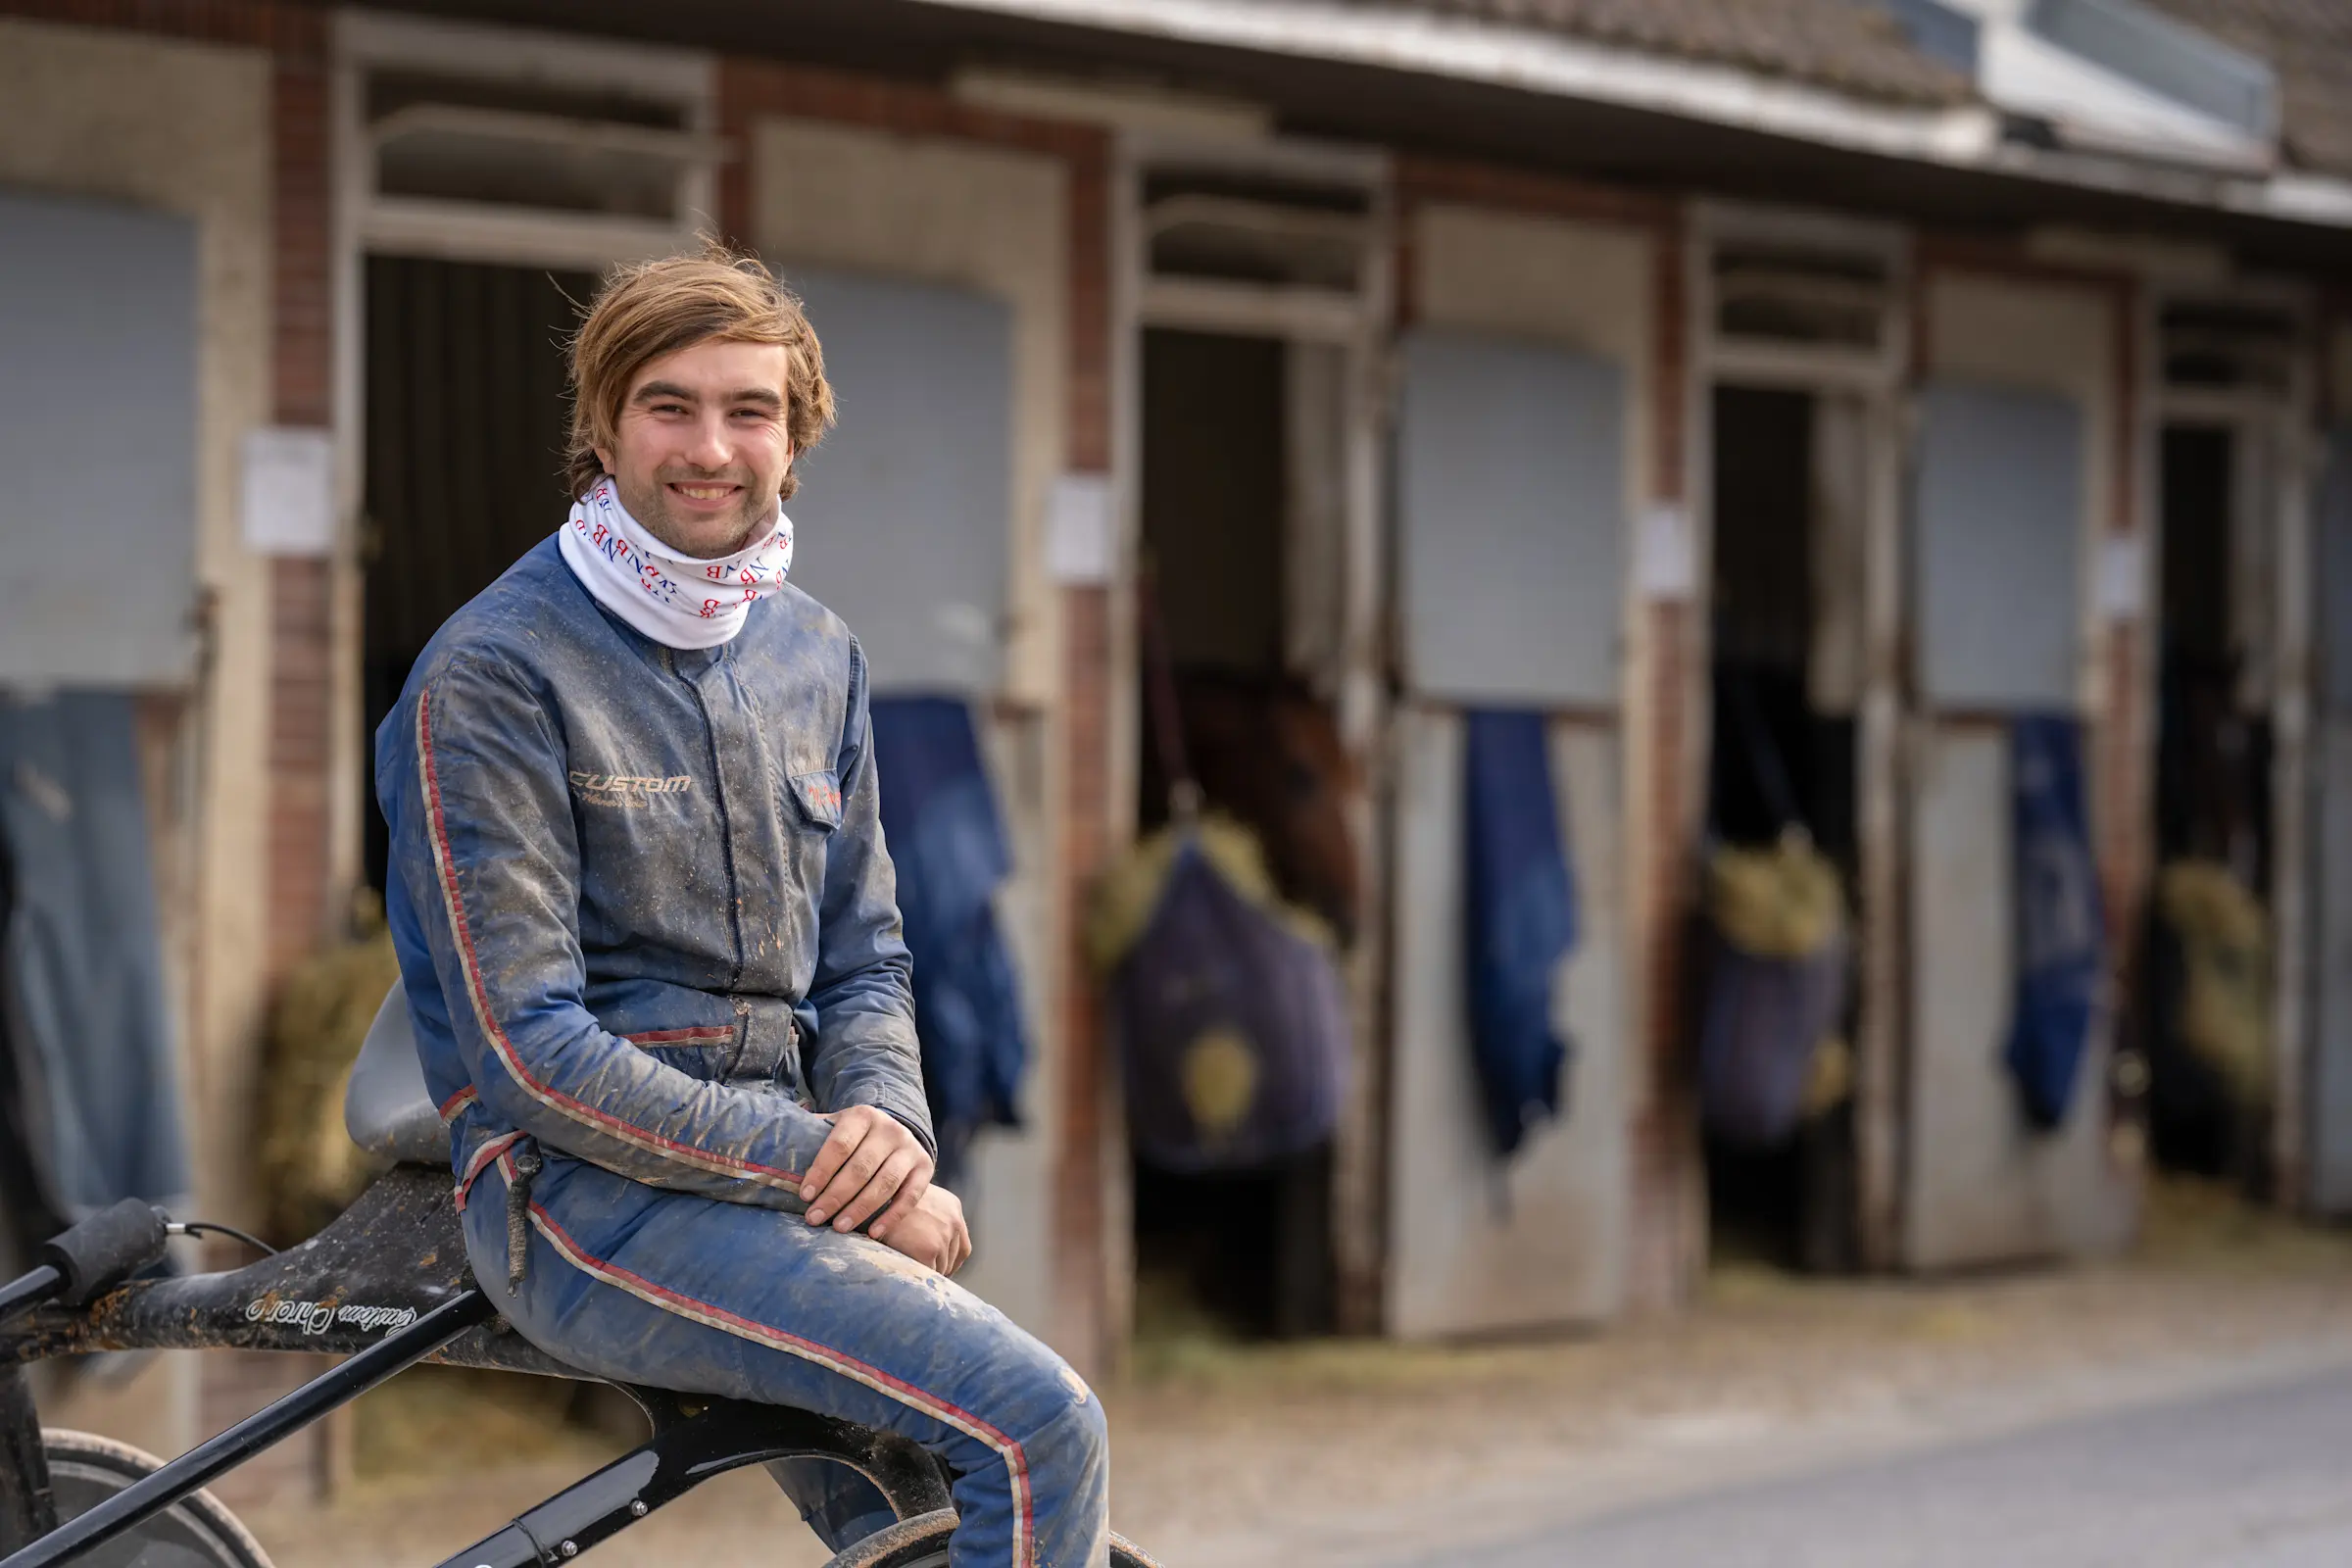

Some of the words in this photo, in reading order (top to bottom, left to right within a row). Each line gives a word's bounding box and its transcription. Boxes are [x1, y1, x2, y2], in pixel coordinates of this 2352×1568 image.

[707, 559, 742, 579] NB
[568, 770, 692, 793] CUSTOM
[337, 1304, 417, 1338] Custom
